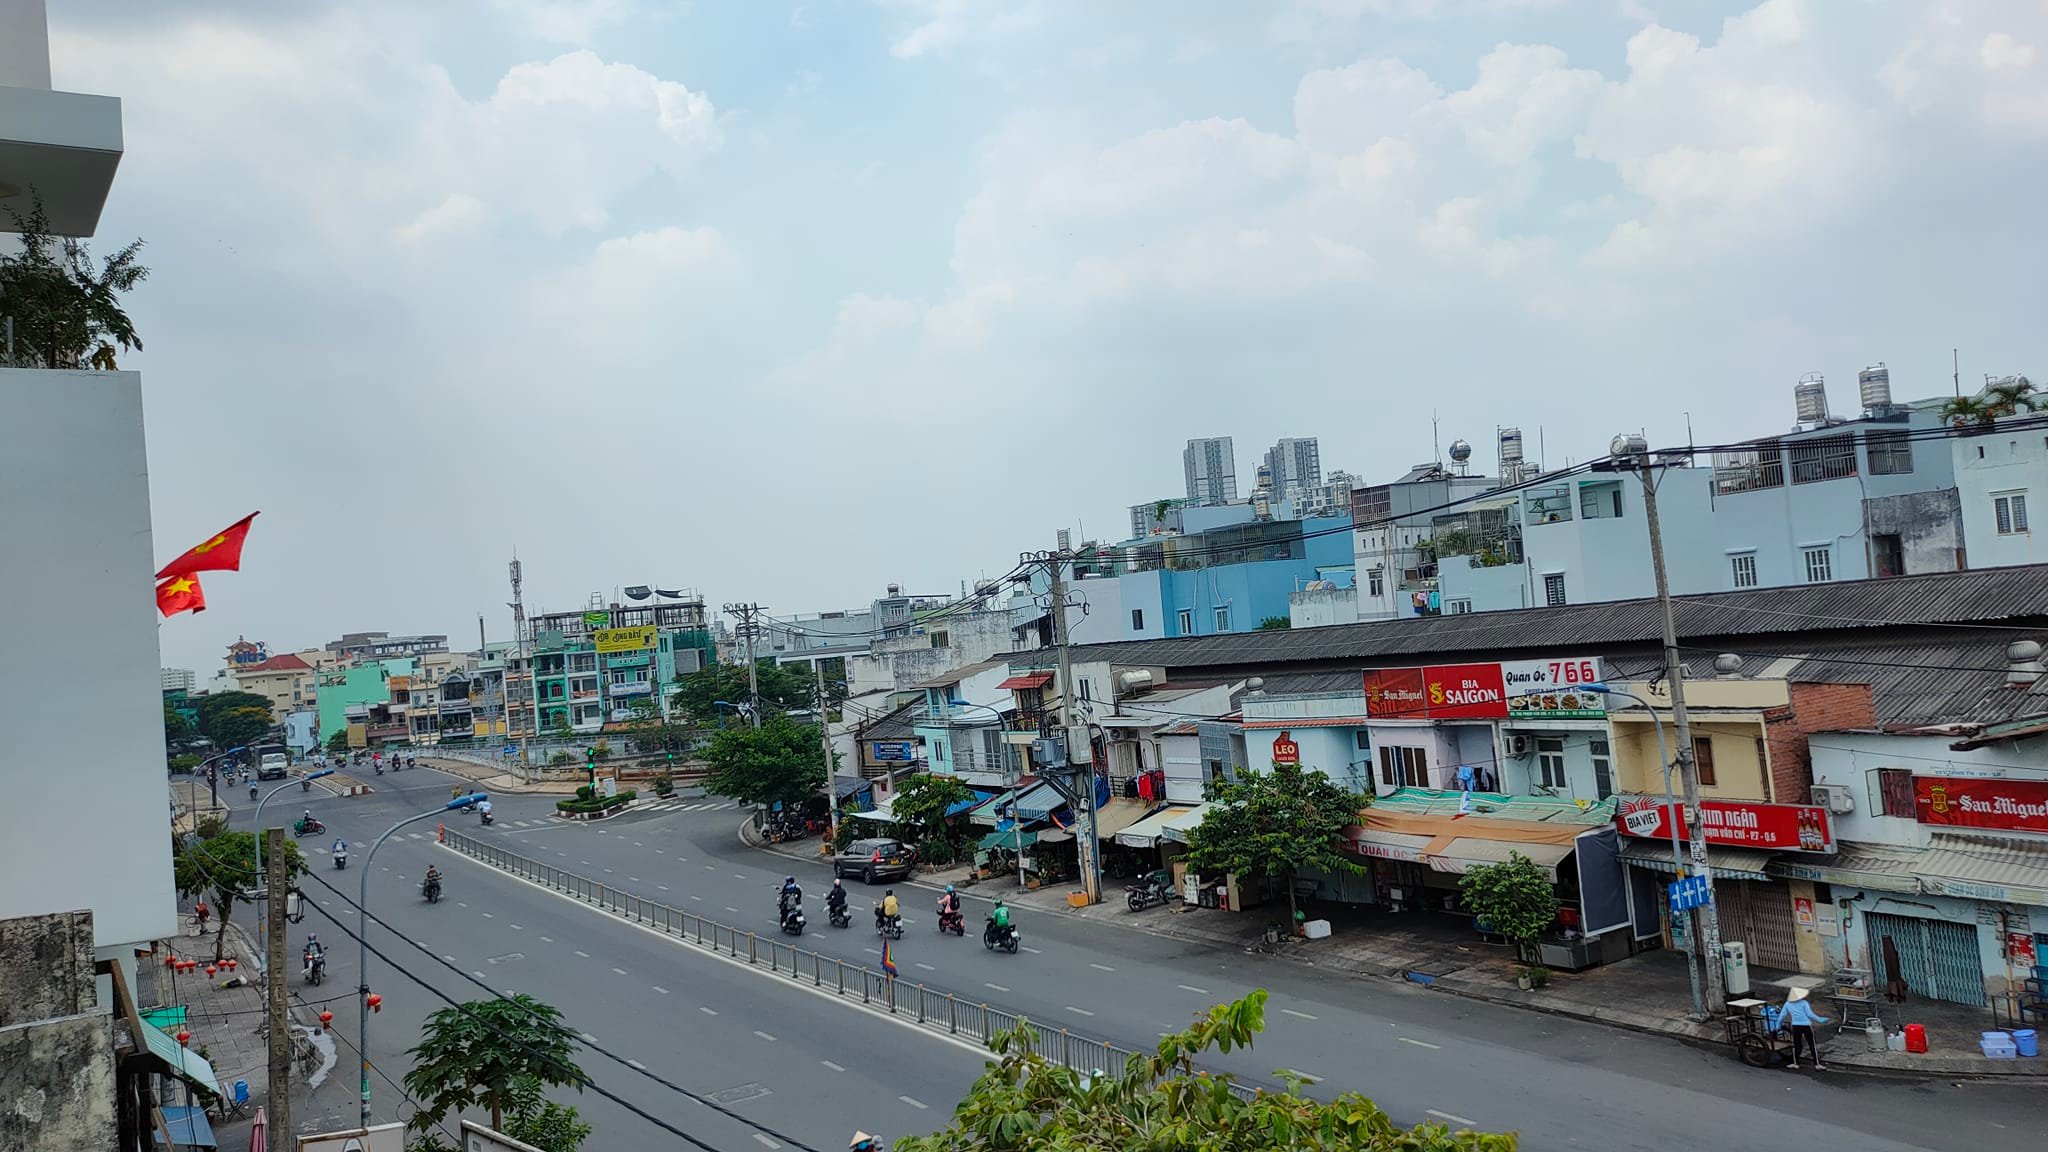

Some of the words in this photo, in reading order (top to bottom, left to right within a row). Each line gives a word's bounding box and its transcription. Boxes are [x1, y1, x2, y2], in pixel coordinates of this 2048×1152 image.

[1548, 661, 1595, 686] 766
[1462, 680, 1479, 689] BIA
[1384, 689, 1398, 700] San
[1446, 689, 1502, 704] SAIGON
[1275, 744, 1295, 755] LEO
[1960, 795, 1991, 812] San
[1627, 816, 1642, 829] BIA
[1725, 808, 1758, 828] NGÂN
